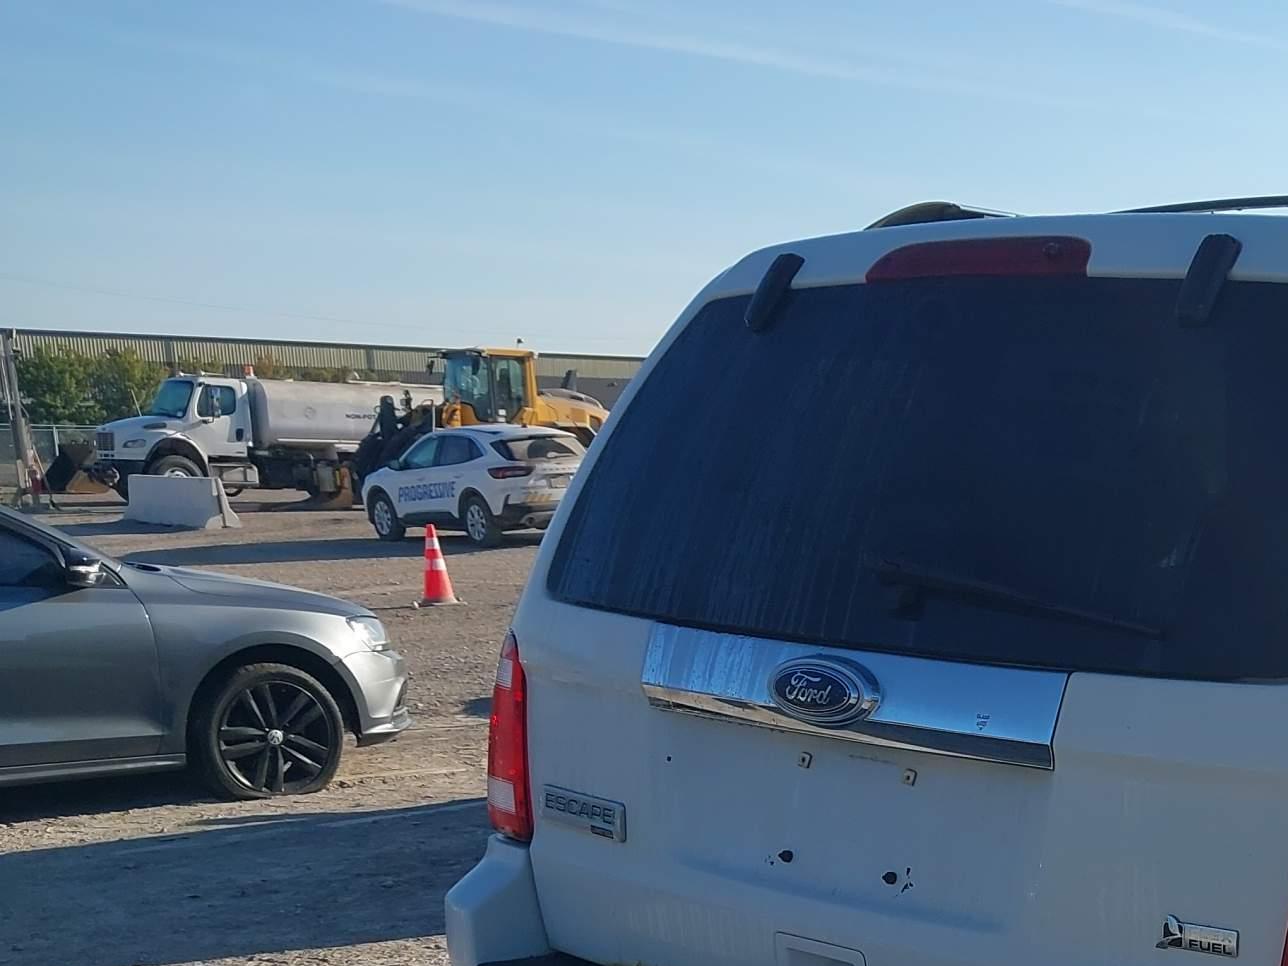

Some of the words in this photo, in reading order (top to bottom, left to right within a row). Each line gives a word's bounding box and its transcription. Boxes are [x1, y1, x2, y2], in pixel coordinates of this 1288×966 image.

[398, 480, 457, 503] PROGRESSIVE
[785, 671, 832, 705] Ford
[544, 792, 615, 826] ESCAPE
[1188, 938, 1234, 956] FUEL
